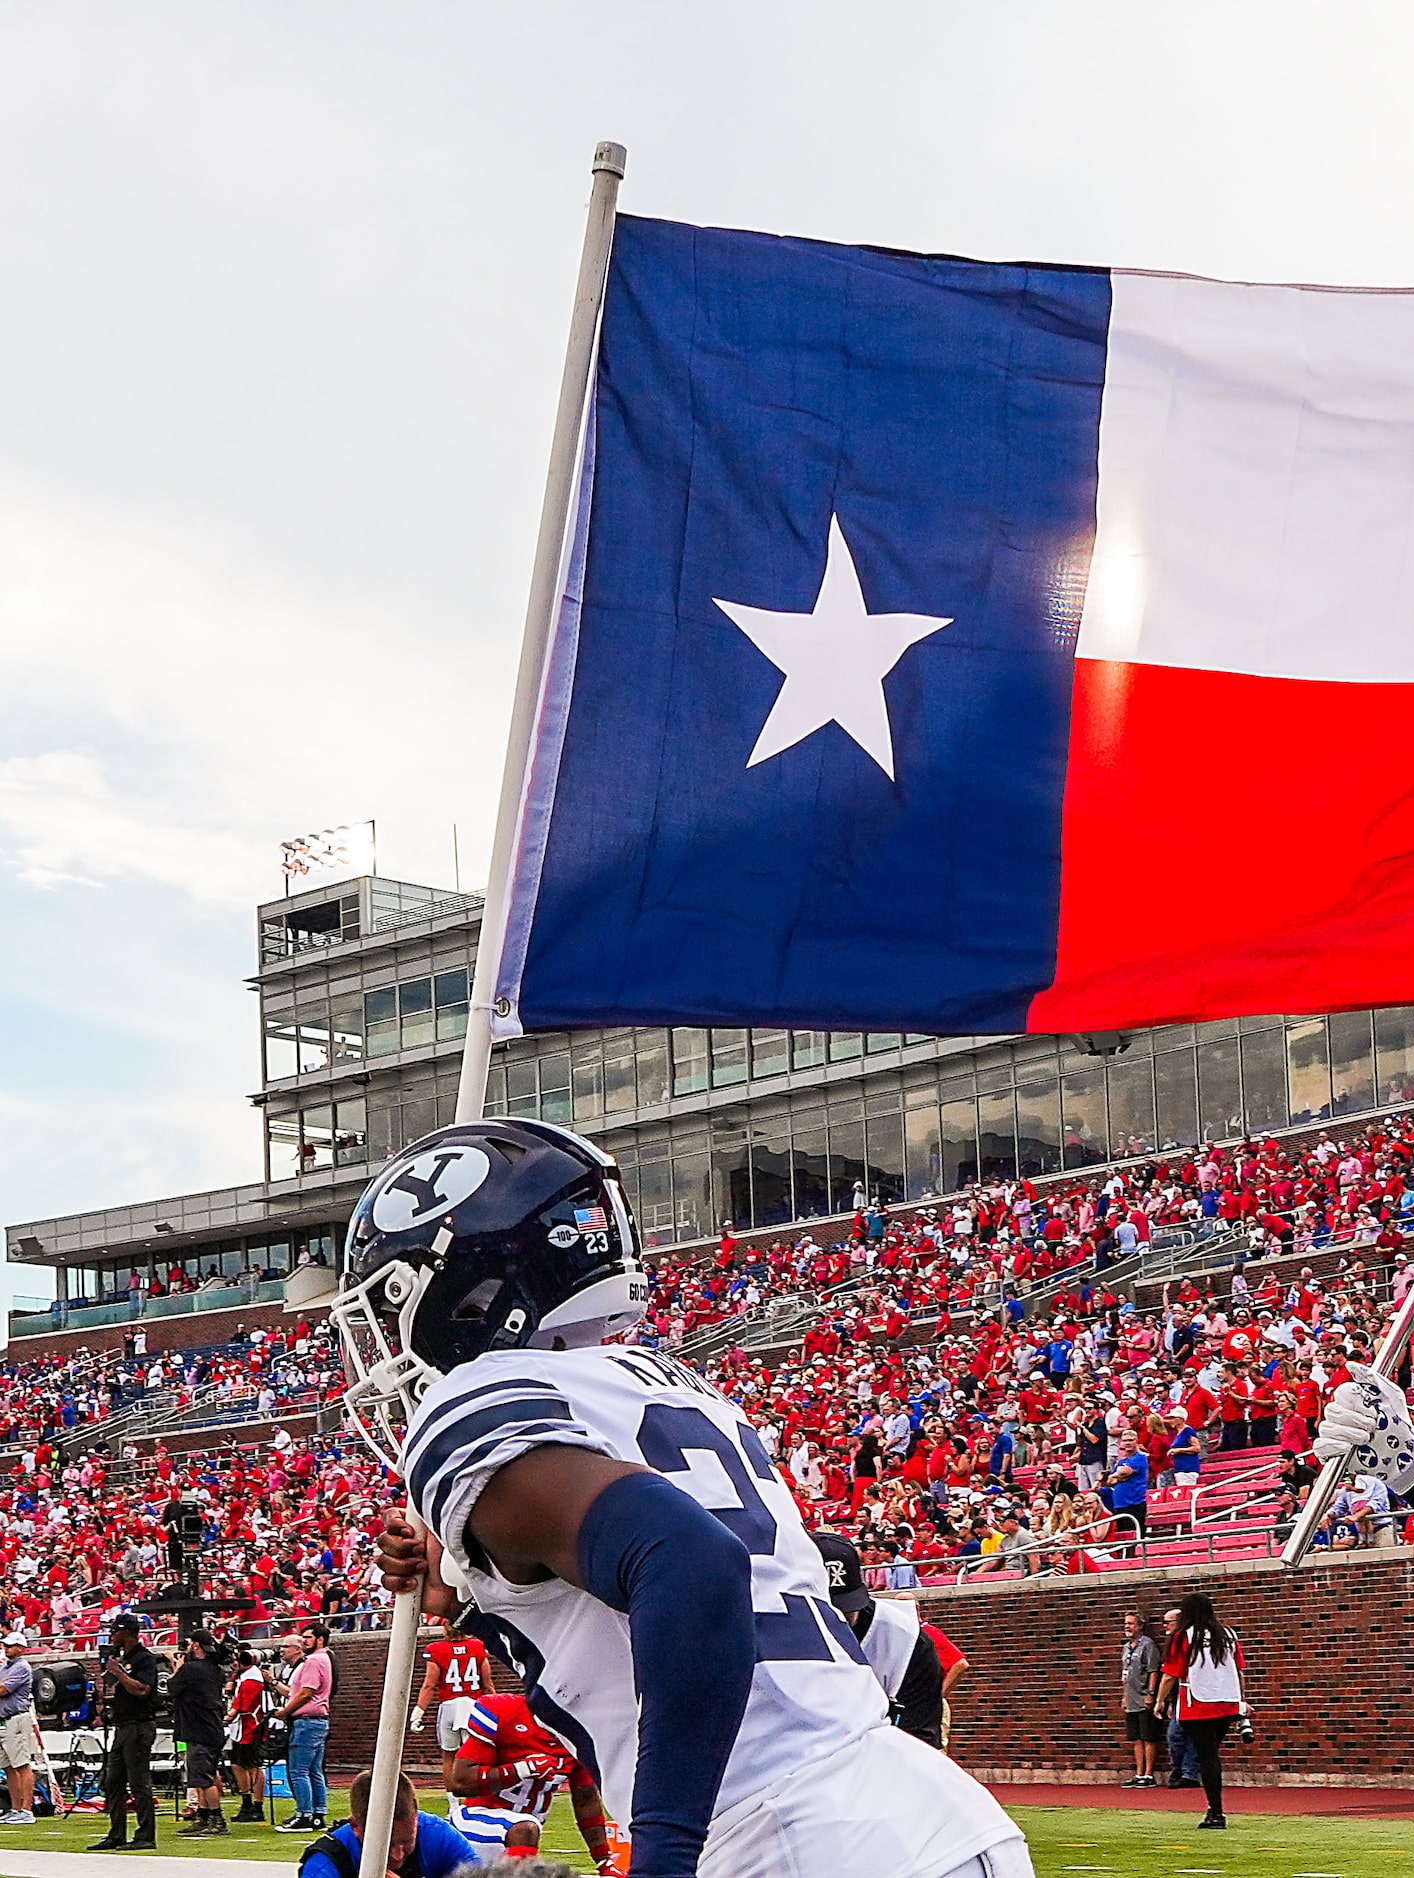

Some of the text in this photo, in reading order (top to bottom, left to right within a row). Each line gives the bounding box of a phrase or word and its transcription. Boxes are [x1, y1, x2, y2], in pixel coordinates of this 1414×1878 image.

[385, 1151, 463, 1218] Y
[556, 1231, 571, 1242] 100
[584, 1231, 609, 1255] 23
[445, 1656, 480, 1692] 44
